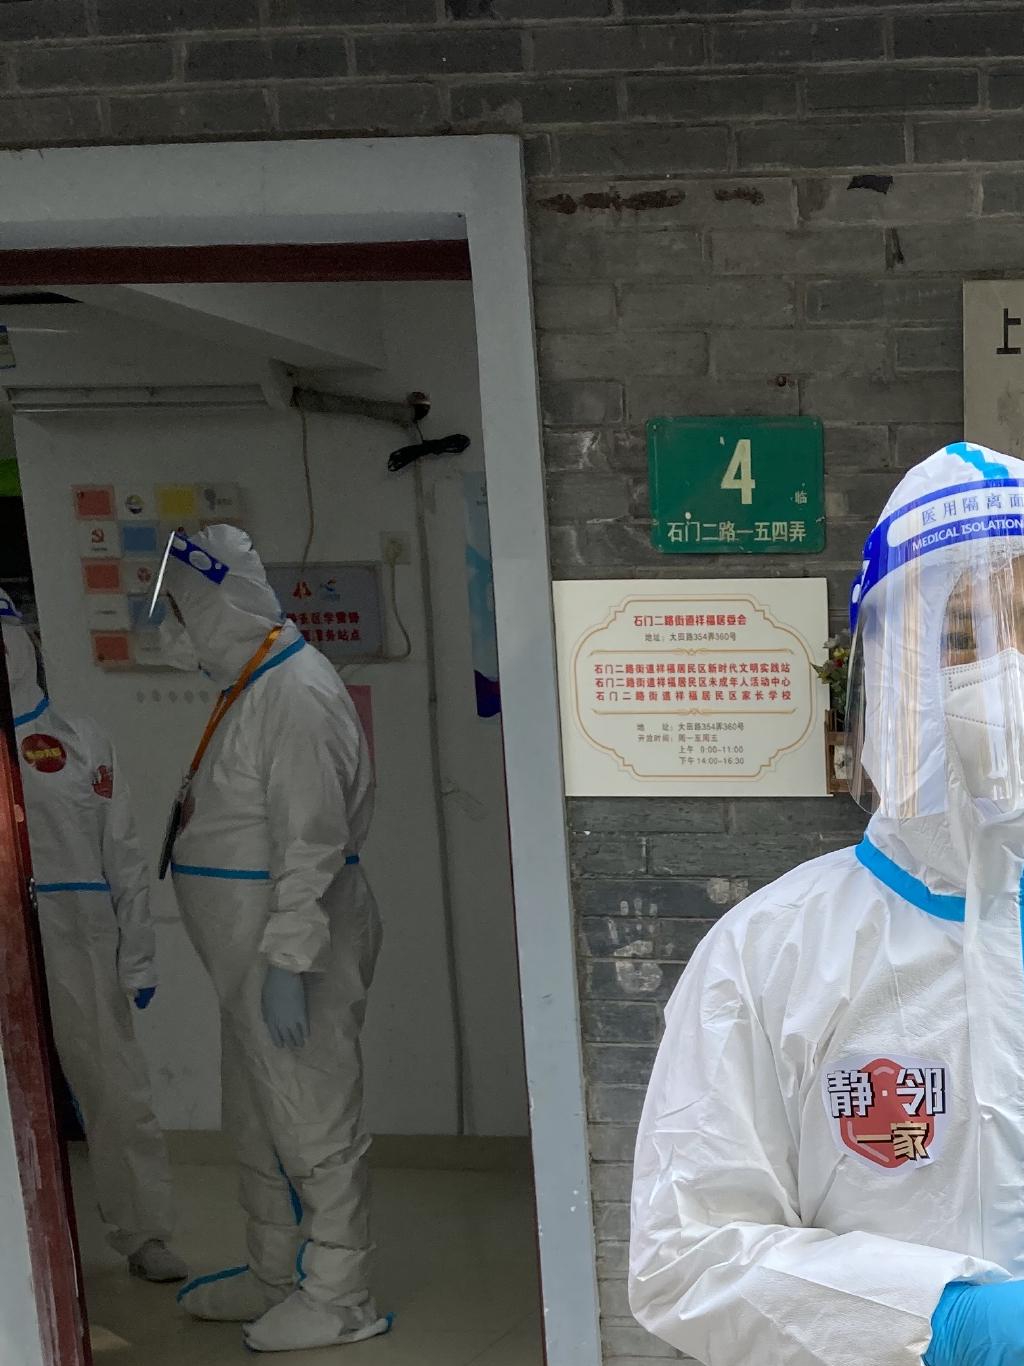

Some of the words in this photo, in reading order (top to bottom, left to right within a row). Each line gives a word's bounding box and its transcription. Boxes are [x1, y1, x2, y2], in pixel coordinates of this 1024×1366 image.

[720, 439, 756, 505] 4
[794, 490, 808, 505] 临
[667, 521, 807, 542] 石门二路一五四弄
[912, 526, 960, 551] MEDICAL
[961, 518, 1024, 536] ISOLATION
[634, 614, 747, 627] 石门二路街道祥福居委会
[594, 663, 791, 675] 石门二路街道祥福居民区新时代文明实践站
[595, 677, 791, 688] 石门二路街道祥福居民区未成年人活动中心
[857, 1121, 931, 1161] 一家
